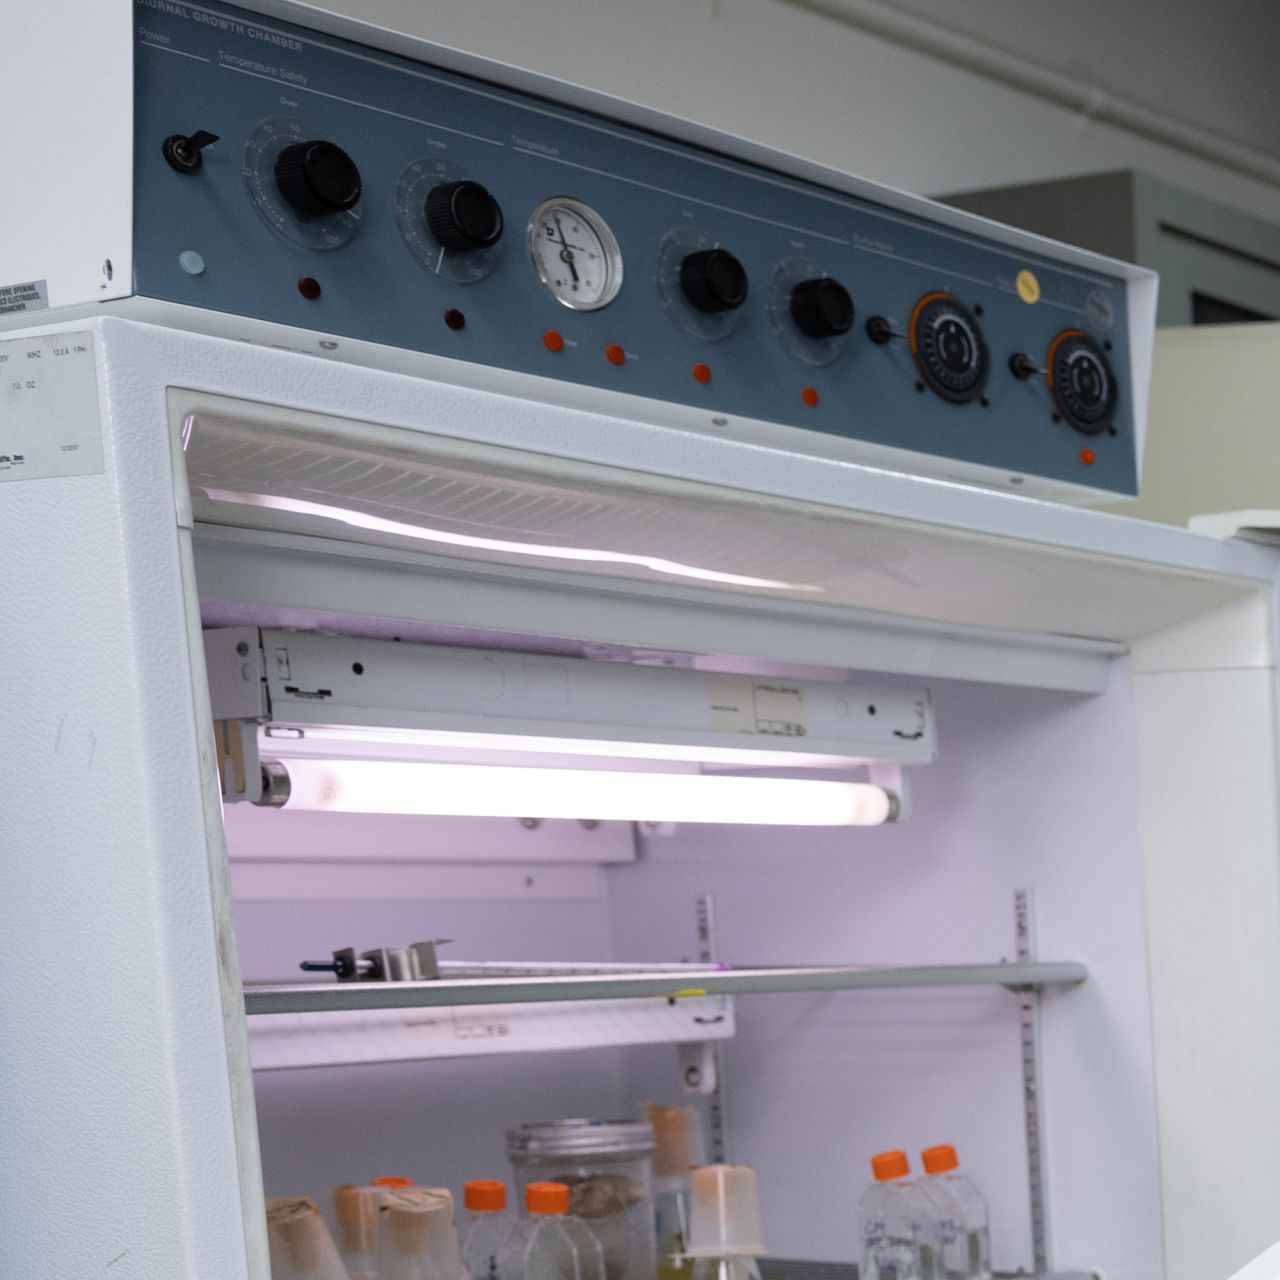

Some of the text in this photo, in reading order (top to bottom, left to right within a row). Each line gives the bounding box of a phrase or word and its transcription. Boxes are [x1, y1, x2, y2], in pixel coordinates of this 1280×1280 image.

[139, 27, 171, 44] Power
[193, 11, 245, 34] GROWTH
[247, 28, 303, 52] CHAMBER
[218, 50, 308, 86] Temperature Safety
[13, 283, 36, 294] OPENING
